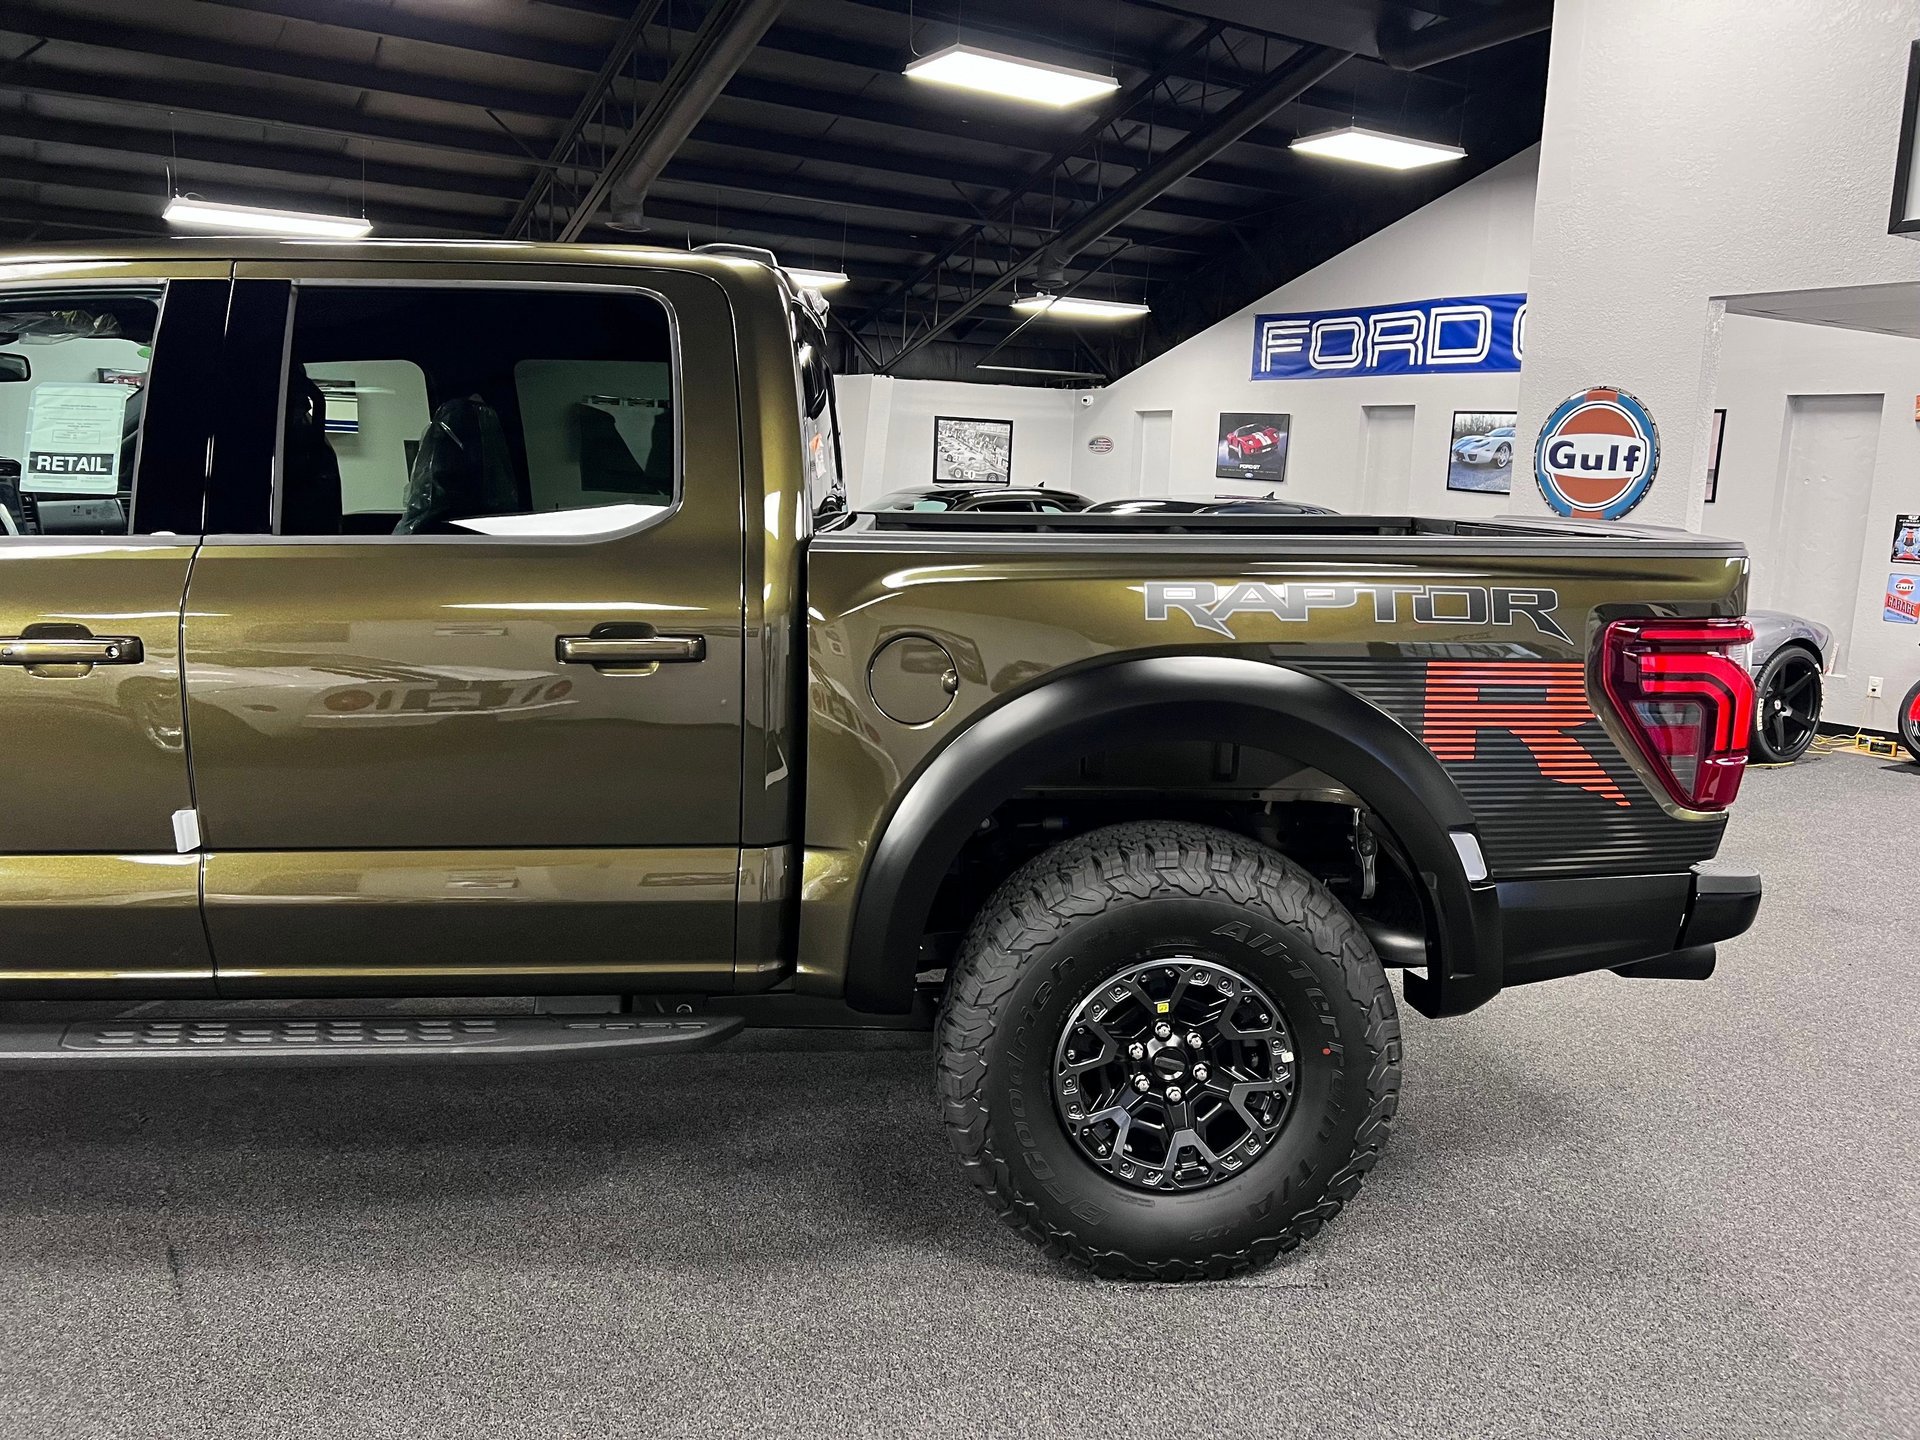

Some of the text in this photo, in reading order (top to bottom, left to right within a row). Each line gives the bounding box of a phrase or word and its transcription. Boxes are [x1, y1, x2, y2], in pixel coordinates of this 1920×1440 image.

[1261, 305, 1492, 372] FORD
[36, 455, 107, 472] RETAIL
[1548, 440, 1641, 472] Gulf
[1886, 594, 1916, 617] GARAGE
[1895, 582, 1914, 591] Gulf
[1144, 581, 1574, 646] RAPTOR
[1423, 661, 1632, 807] R
[1007, 956, 1111, 1226] BFGoodrich
